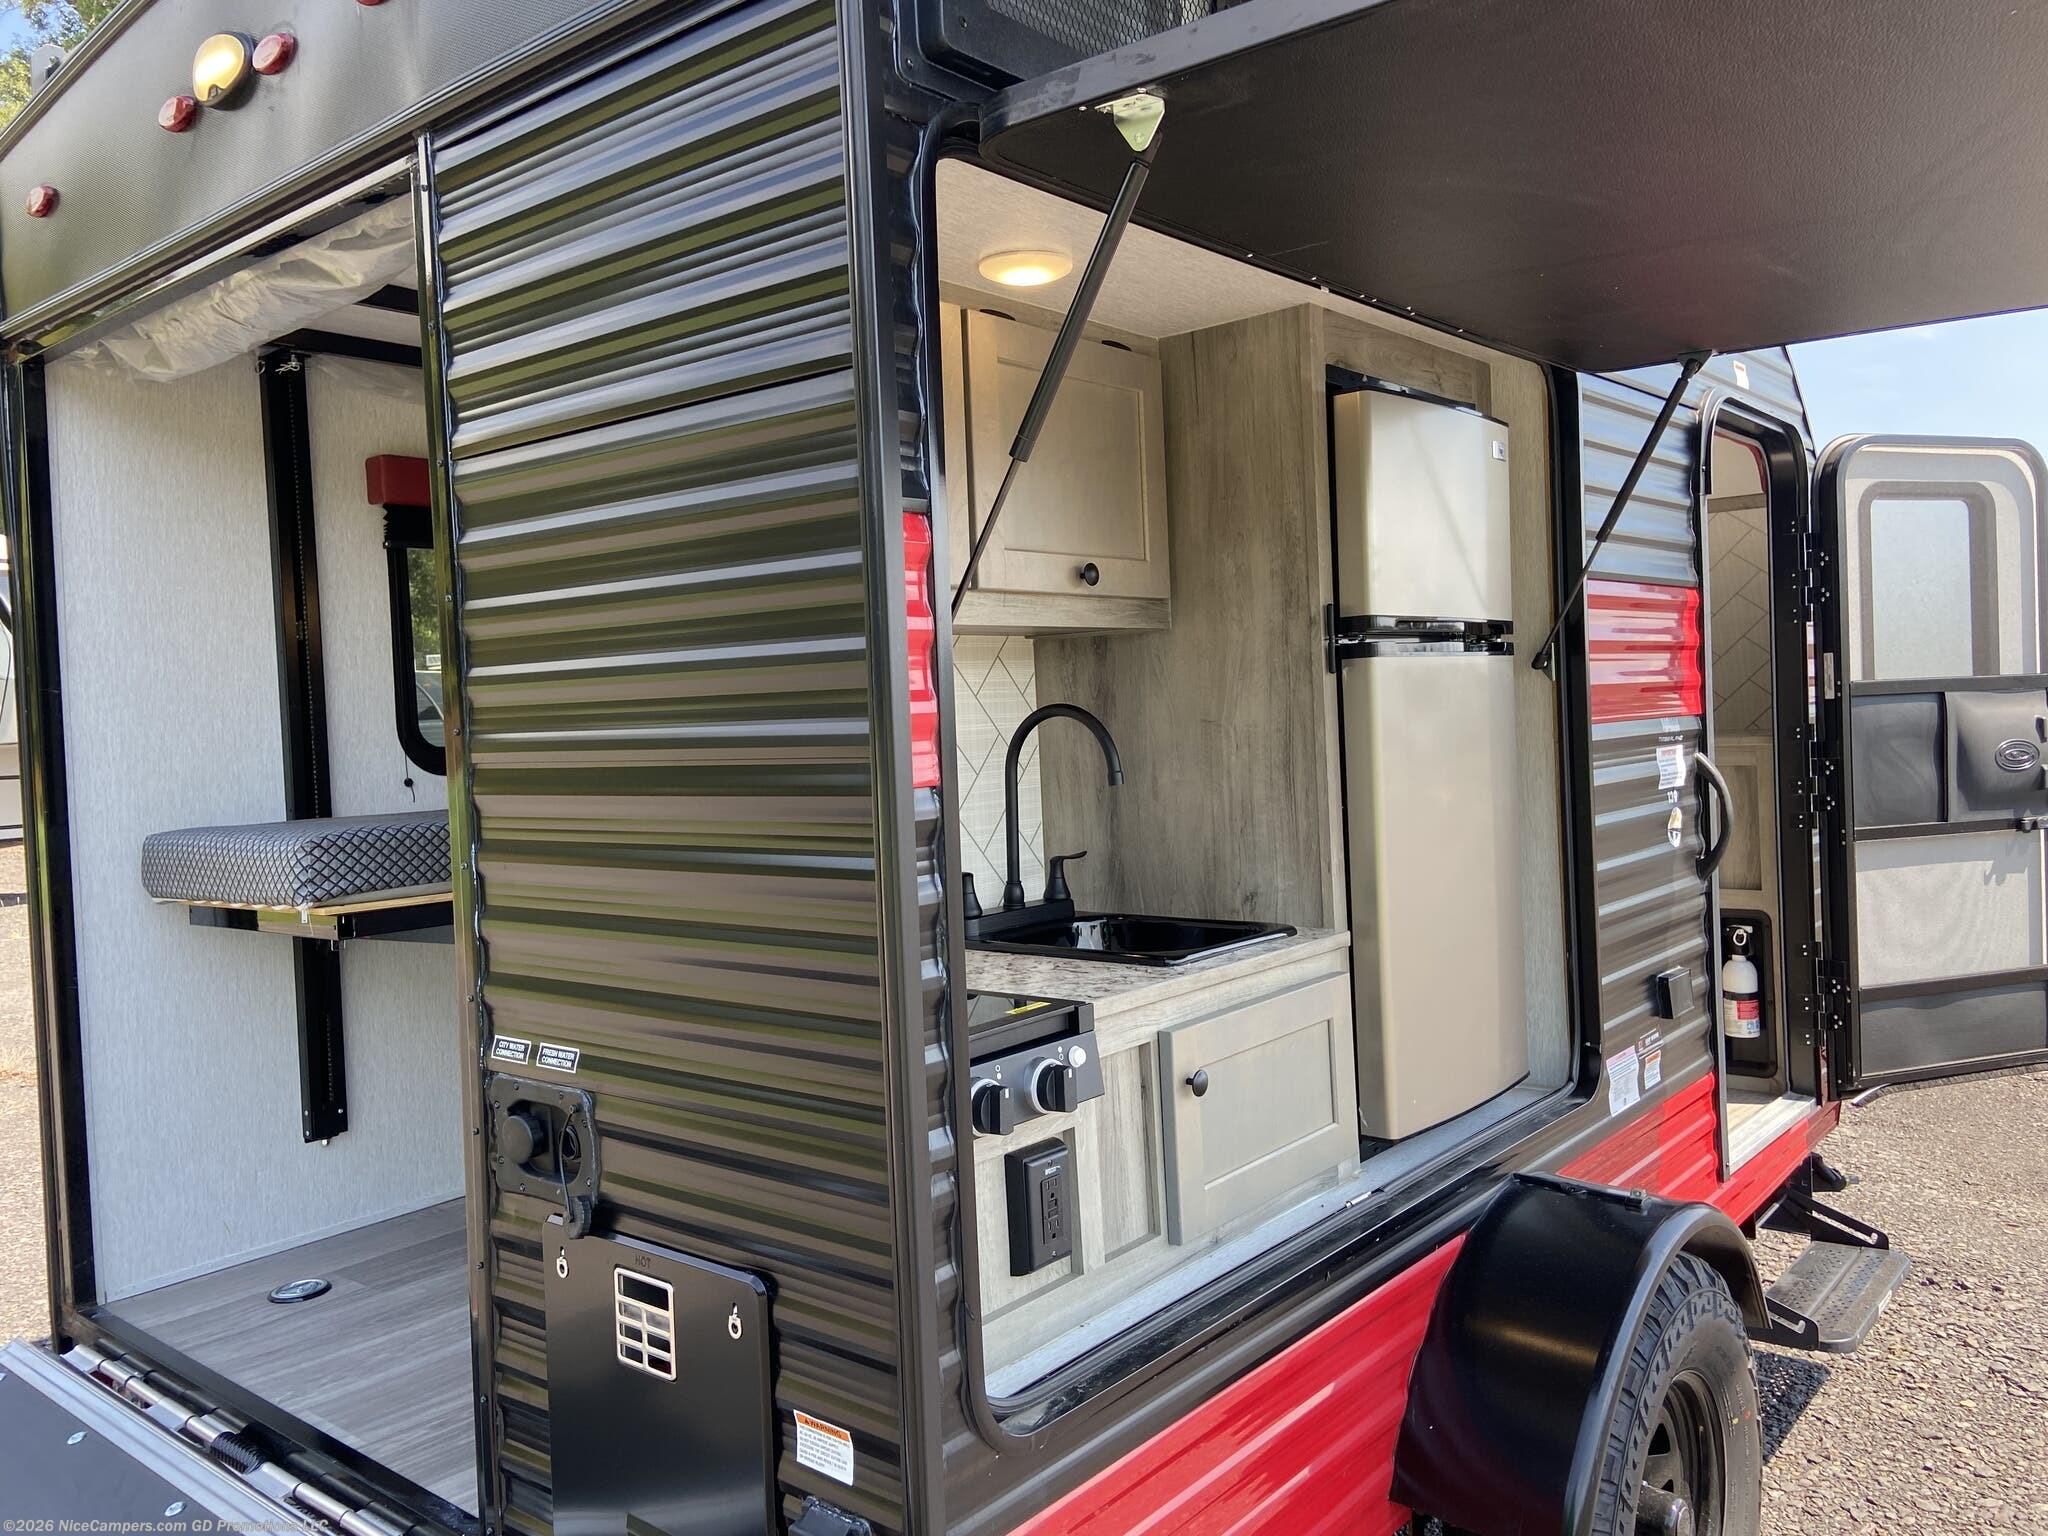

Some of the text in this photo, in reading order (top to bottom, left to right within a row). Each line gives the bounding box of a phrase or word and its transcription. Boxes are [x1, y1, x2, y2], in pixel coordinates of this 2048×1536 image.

[499, 1040, 525, 1052] CITY WATER
[495, 1048, 525, 1060] CONNECTION
[542, 1047, 575, 1061] FRESH WATER
[541, 1055, 572, 1068] CONNECTION
[635, 1254, 651, 1269] HOT
